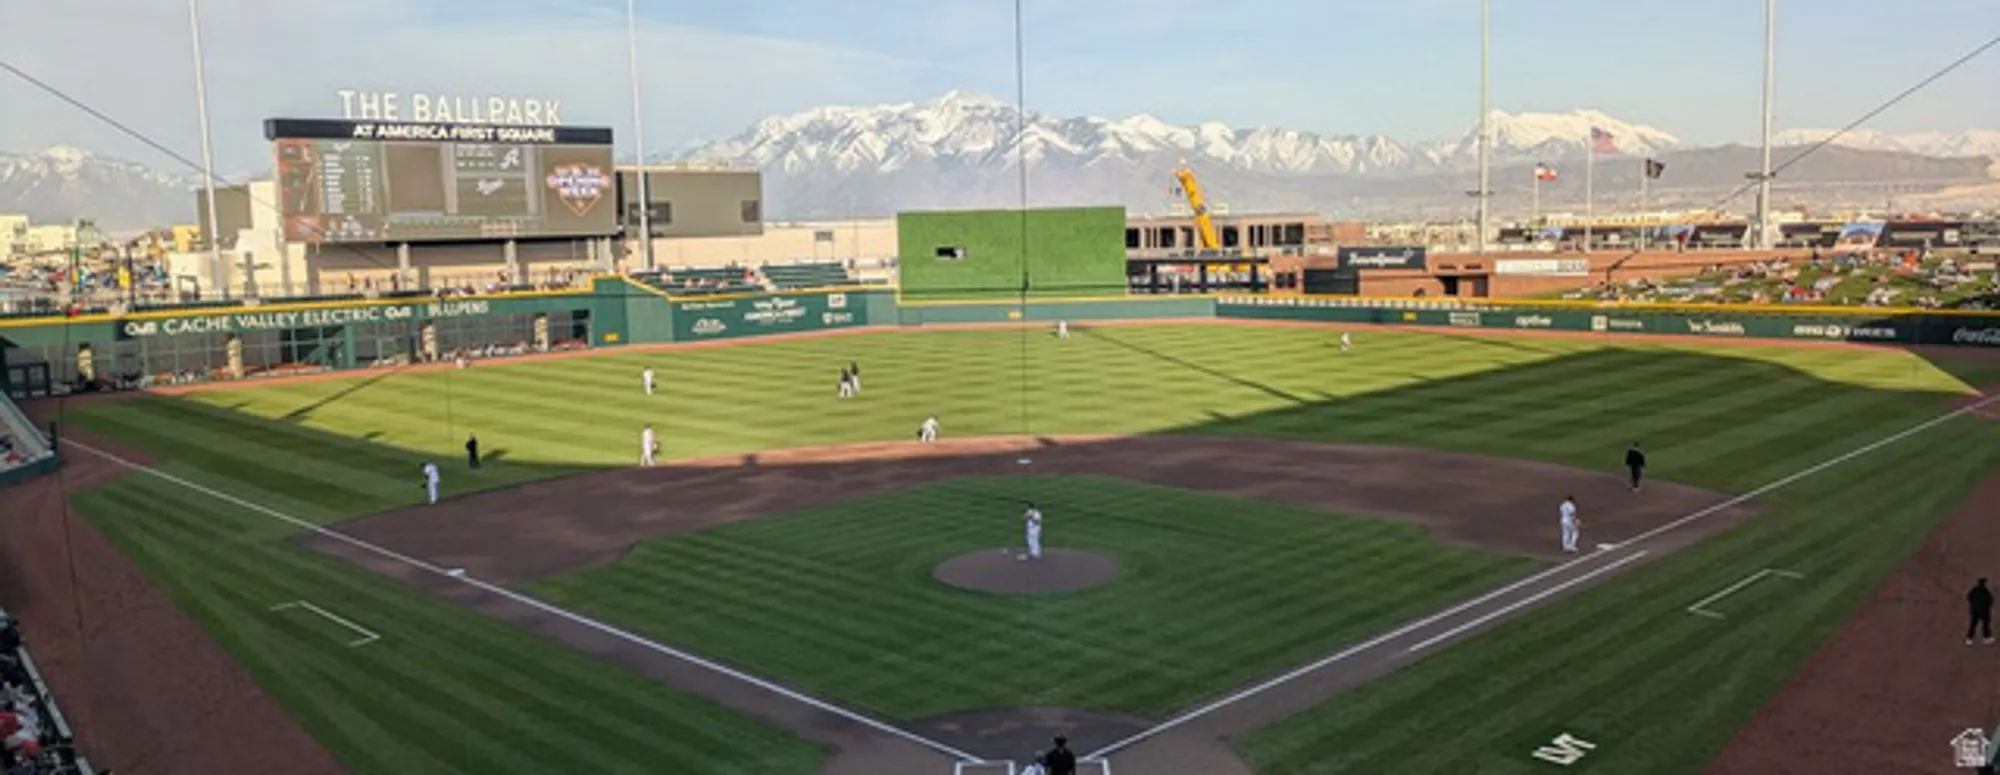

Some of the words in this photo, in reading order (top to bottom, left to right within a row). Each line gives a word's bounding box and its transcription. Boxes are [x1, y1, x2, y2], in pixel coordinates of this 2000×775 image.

[337, 90, 399, 120] THE
[412, 93, 562, 126] BALLPARK
[353, 123, 375, 137] AT
[376, 123, 449, 139] AMERICA
[450, 126, 495, 140] FIRST
[497, 127, 555, 142] SQUARE
[162, 316, 233, 335] CACHE
[234, 311, 299, 329] VALLEY
[302, 306, 381, 326] ELECTRIC
